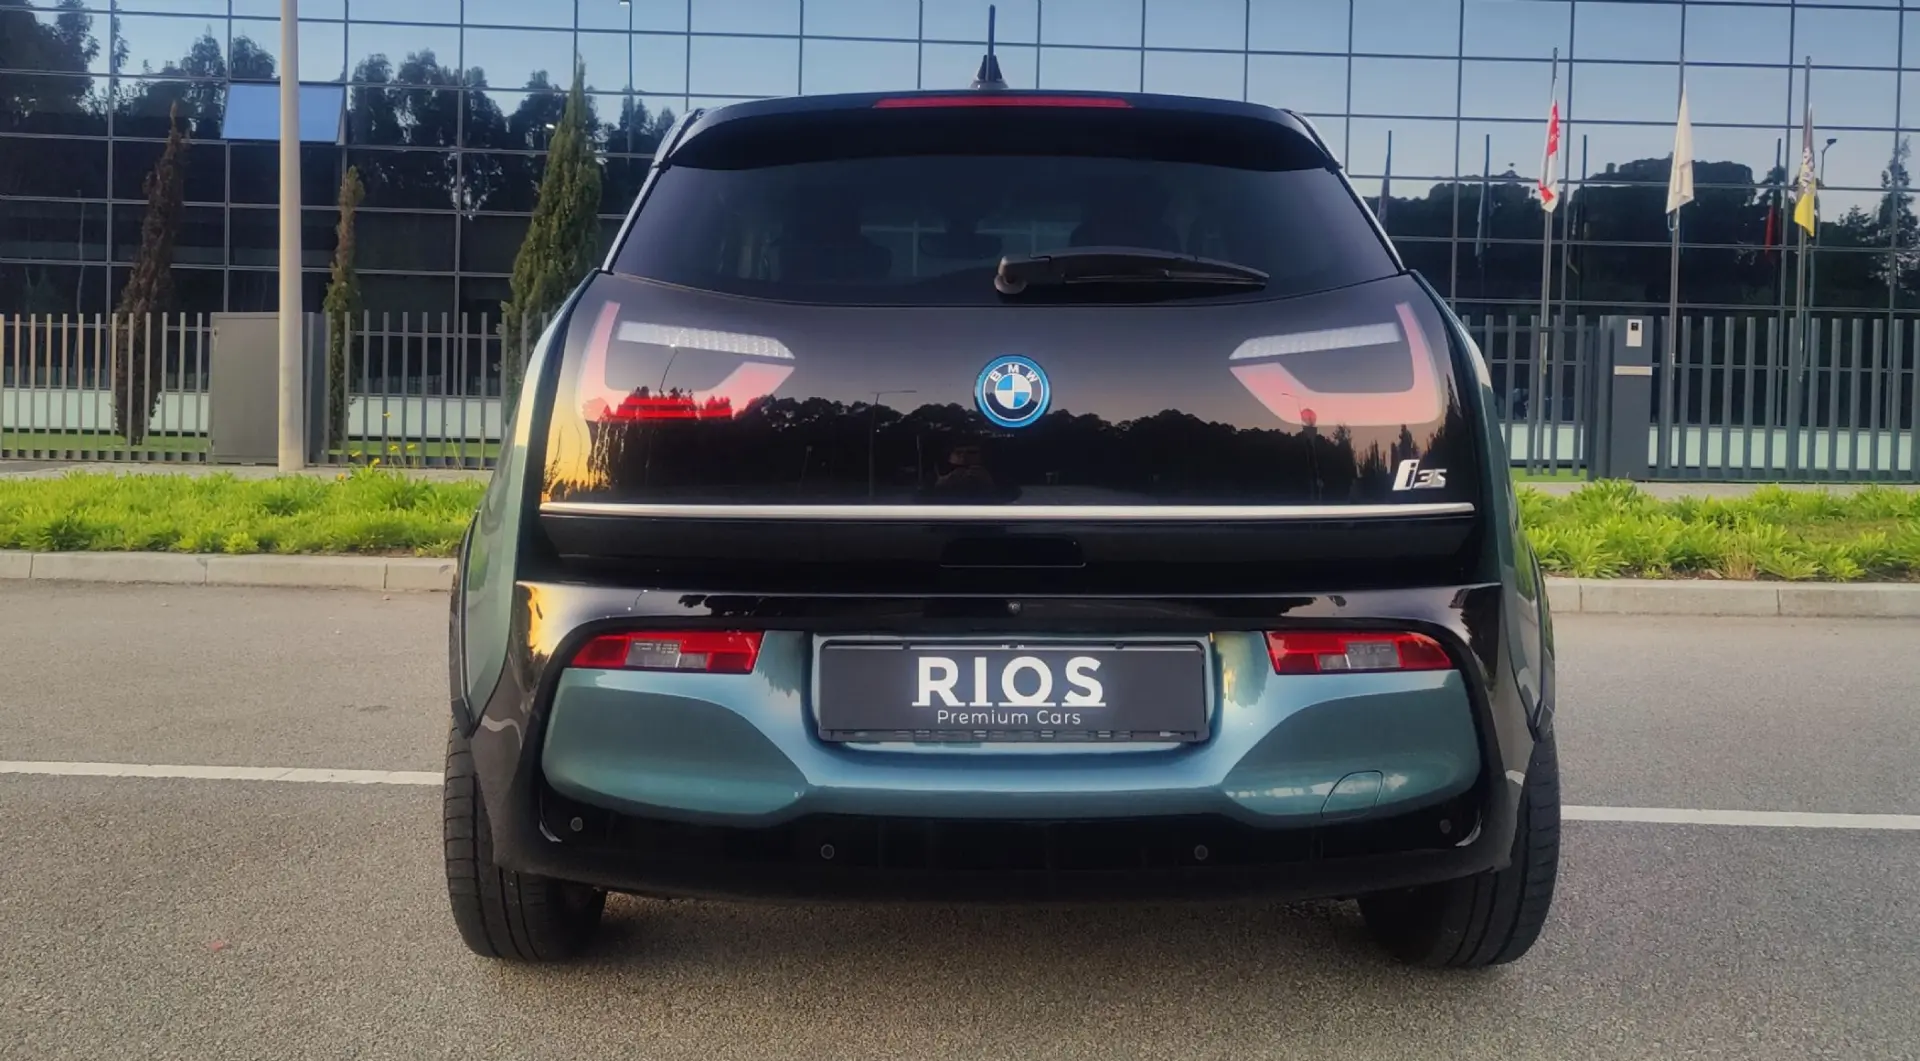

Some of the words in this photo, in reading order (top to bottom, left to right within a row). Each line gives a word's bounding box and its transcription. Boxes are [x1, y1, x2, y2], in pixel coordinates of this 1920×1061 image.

[990, 364, 1038, 382] BMW
[912, 656, 1106, 707] RIOS
[937, 710, 1028, 725] Premium
[1036, 710, 1081, 725] Cars
